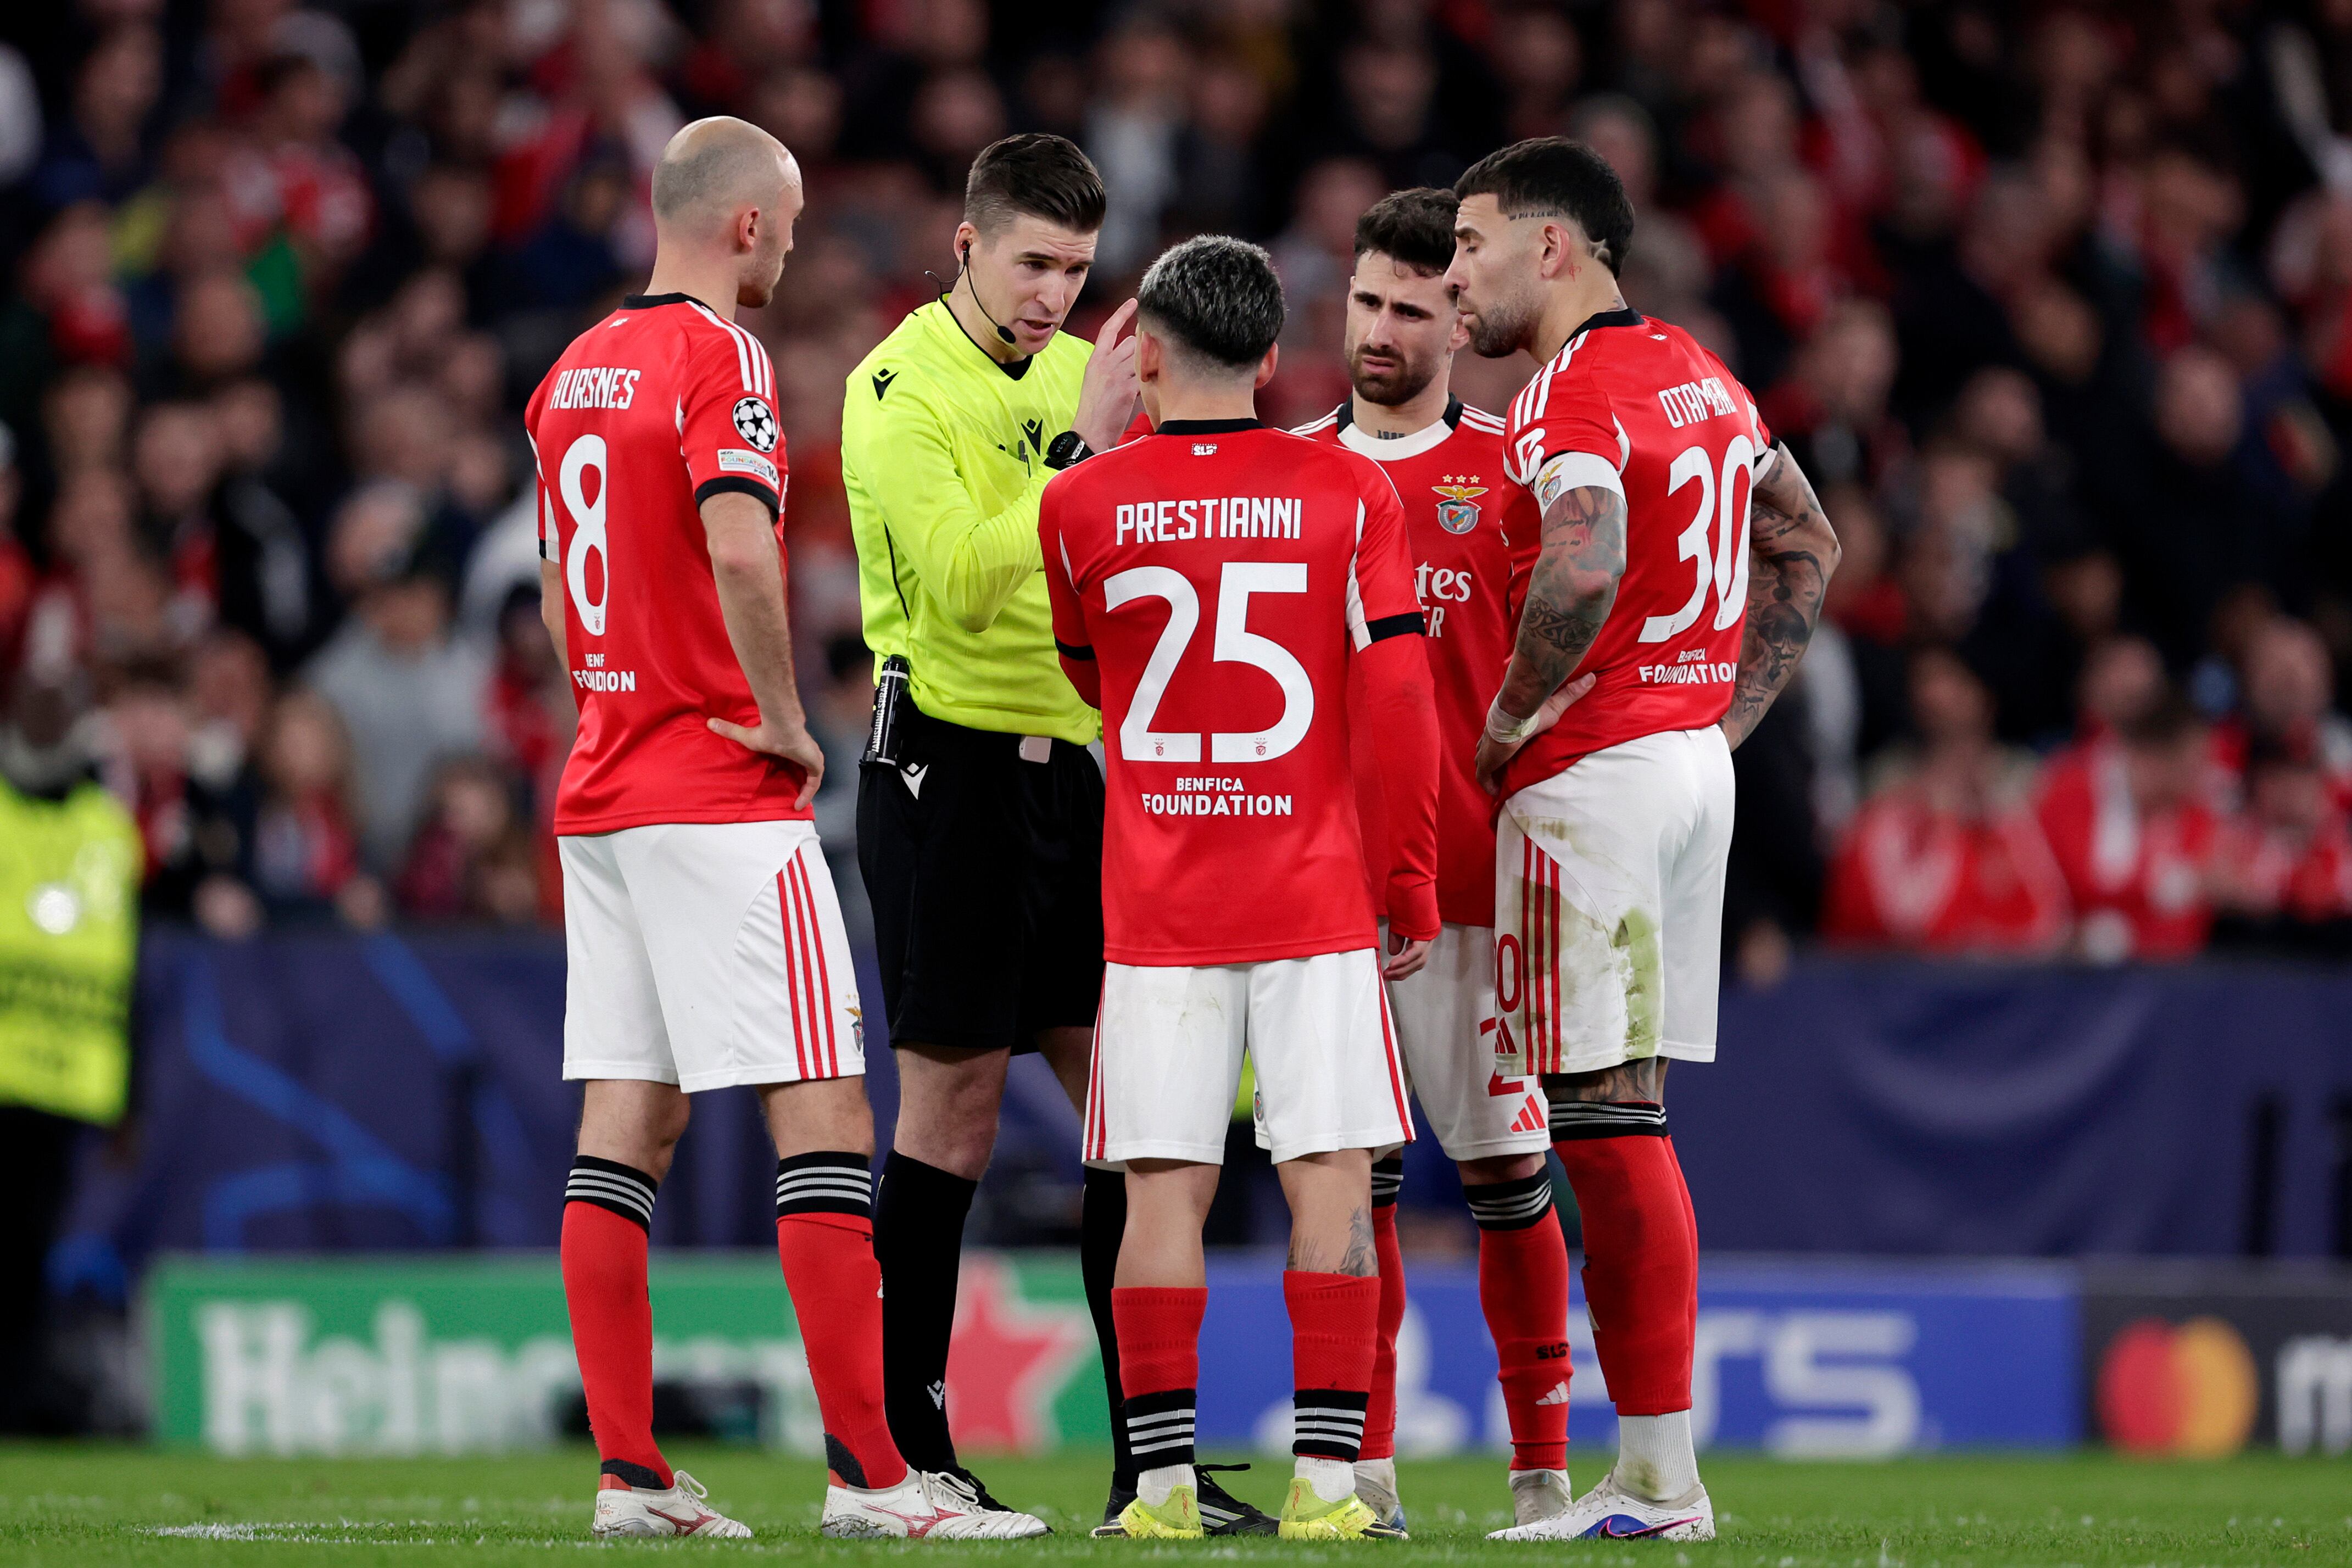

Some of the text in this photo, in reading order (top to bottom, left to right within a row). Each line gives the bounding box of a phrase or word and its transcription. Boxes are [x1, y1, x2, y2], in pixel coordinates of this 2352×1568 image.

[549, 367, 641, 410] AURSNES
[559, 434, 608, 636] 8
[1116, 497, 1302, 546] PRESTIANNI
[1637, 435, 1755, 643] 30
[1103, 562, 1314, 763] 25
[1142, 794, 1292, 816] FOUNDATION
[1177, 778, 1244, 791] BENFICA
